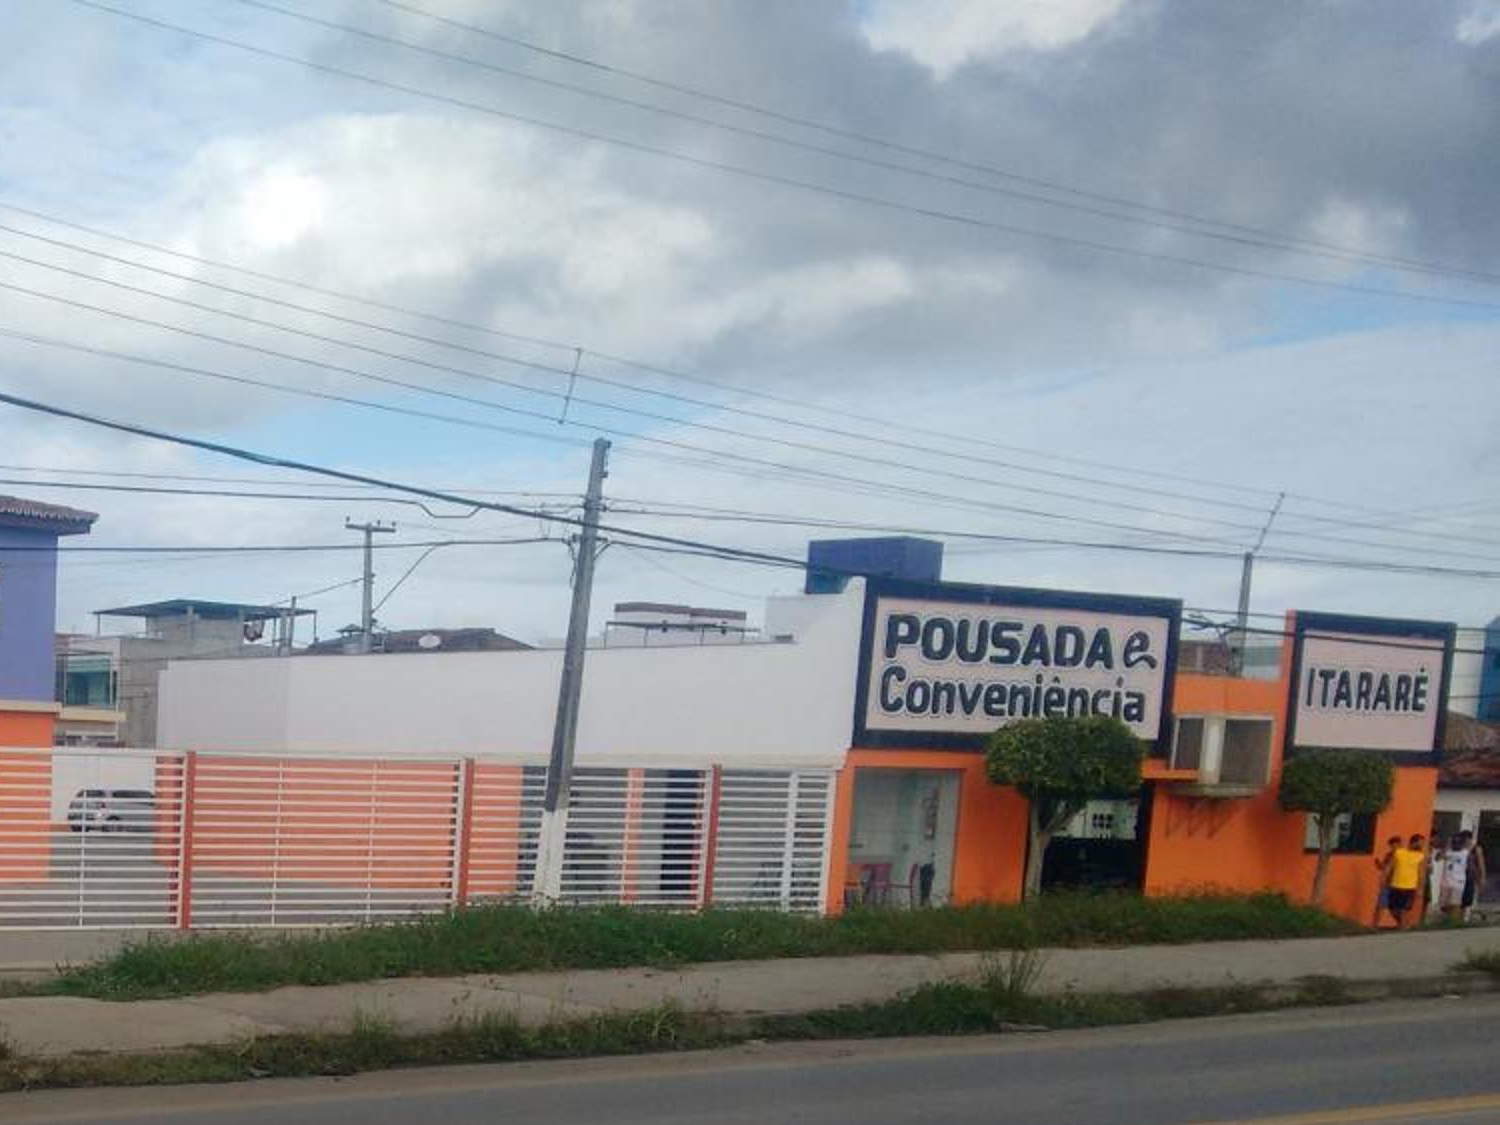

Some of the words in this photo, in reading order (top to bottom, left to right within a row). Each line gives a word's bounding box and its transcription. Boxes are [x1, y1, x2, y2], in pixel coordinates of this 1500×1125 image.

[884, 613, 1114, 669] POUSADA
[1122, 631, 1157, 669] e
[880, 665, 1146, 722] Conveniência
[1305, 667, 1428, 712] ITARARÉ
